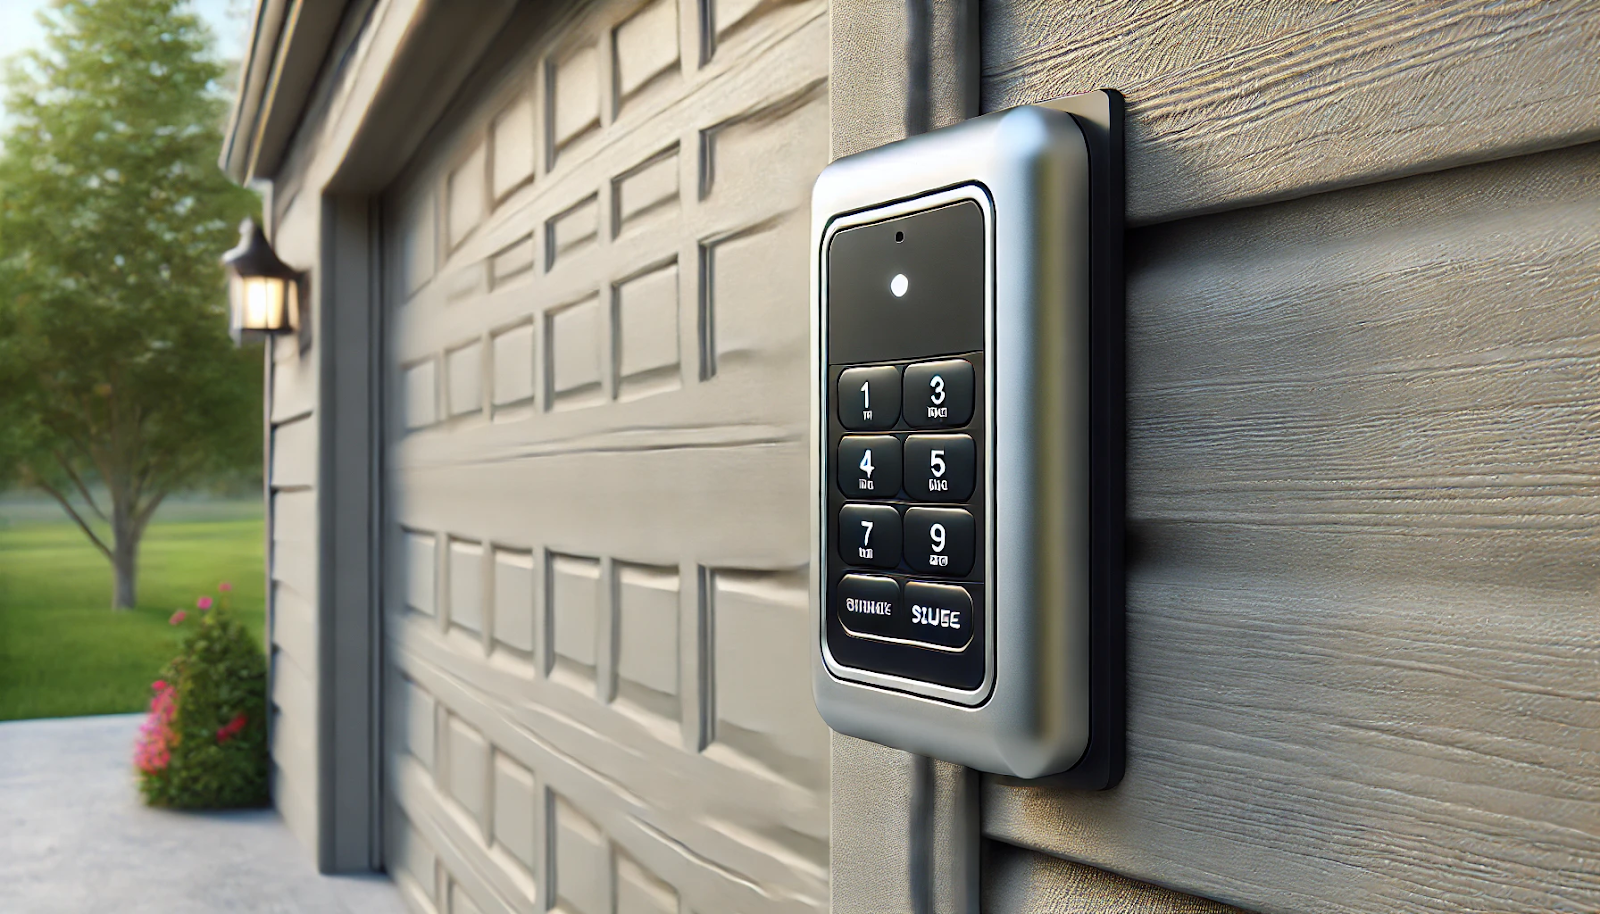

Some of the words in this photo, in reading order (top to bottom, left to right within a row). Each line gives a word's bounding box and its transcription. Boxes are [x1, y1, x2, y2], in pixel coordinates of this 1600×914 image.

[860, 381, 869, 409] 1
[929, 375, 946, 405] 3
[859, 449, 875, 478] 4
[930, 449, 946, 478] 5
[860, 520, 873, 546] 7
[929, 523, 946, 553] 9
